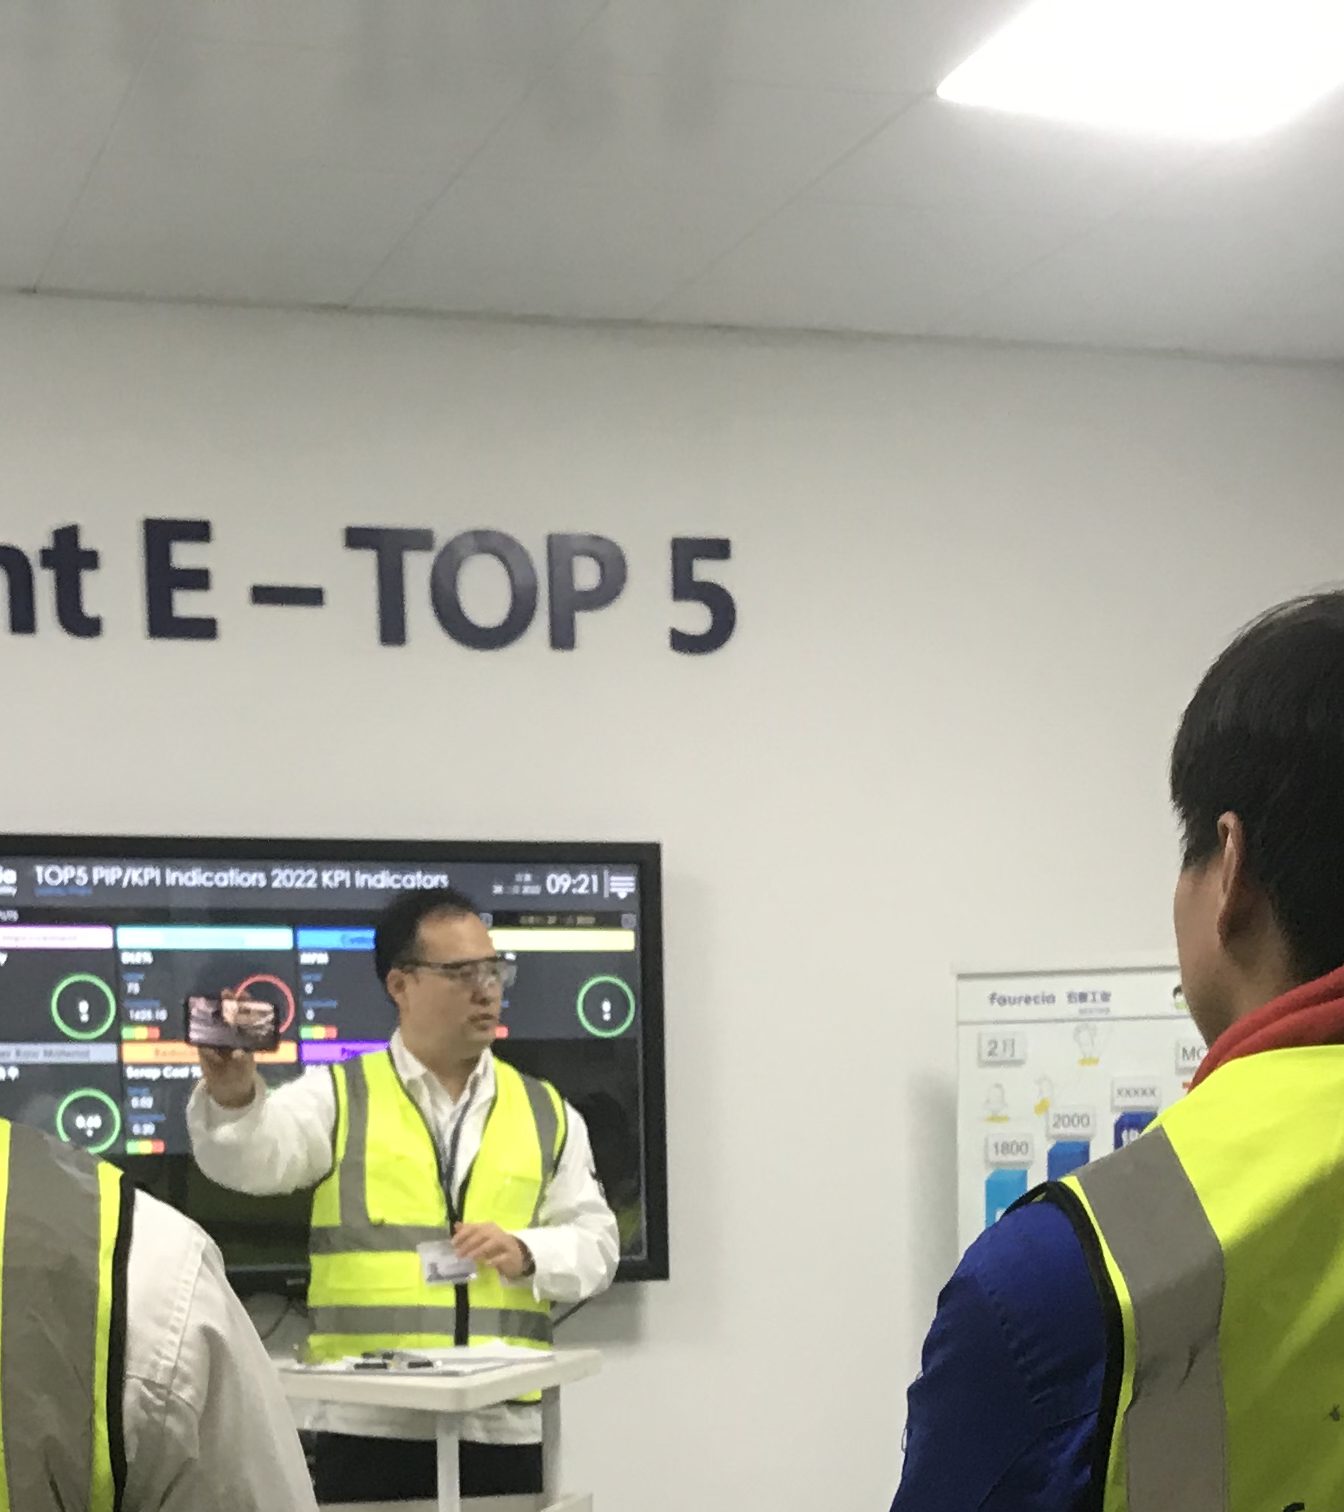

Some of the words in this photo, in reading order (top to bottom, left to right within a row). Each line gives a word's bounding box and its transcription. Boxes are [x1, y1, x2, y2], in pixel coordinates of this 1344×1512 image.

[141, 517, 219, 640] E
[345, 526, 627, 651] TOP
[668, 537, 737, 655] 5
[35, 865, 89, 887] TOP5
[92, 865, 161, 888] PIP/KPI
[271, 868, 317, 888] 2022
[322, 869, 351, 889] KPI
[355, 869, 449, 890] Indicators
[545, 872, 598, 895] 09:21
[988, 991, 1056, 1006] faurecia
[1052, 1113, 1090, 1129] 2000
[993, 1141, 1029, 1157] 1800
